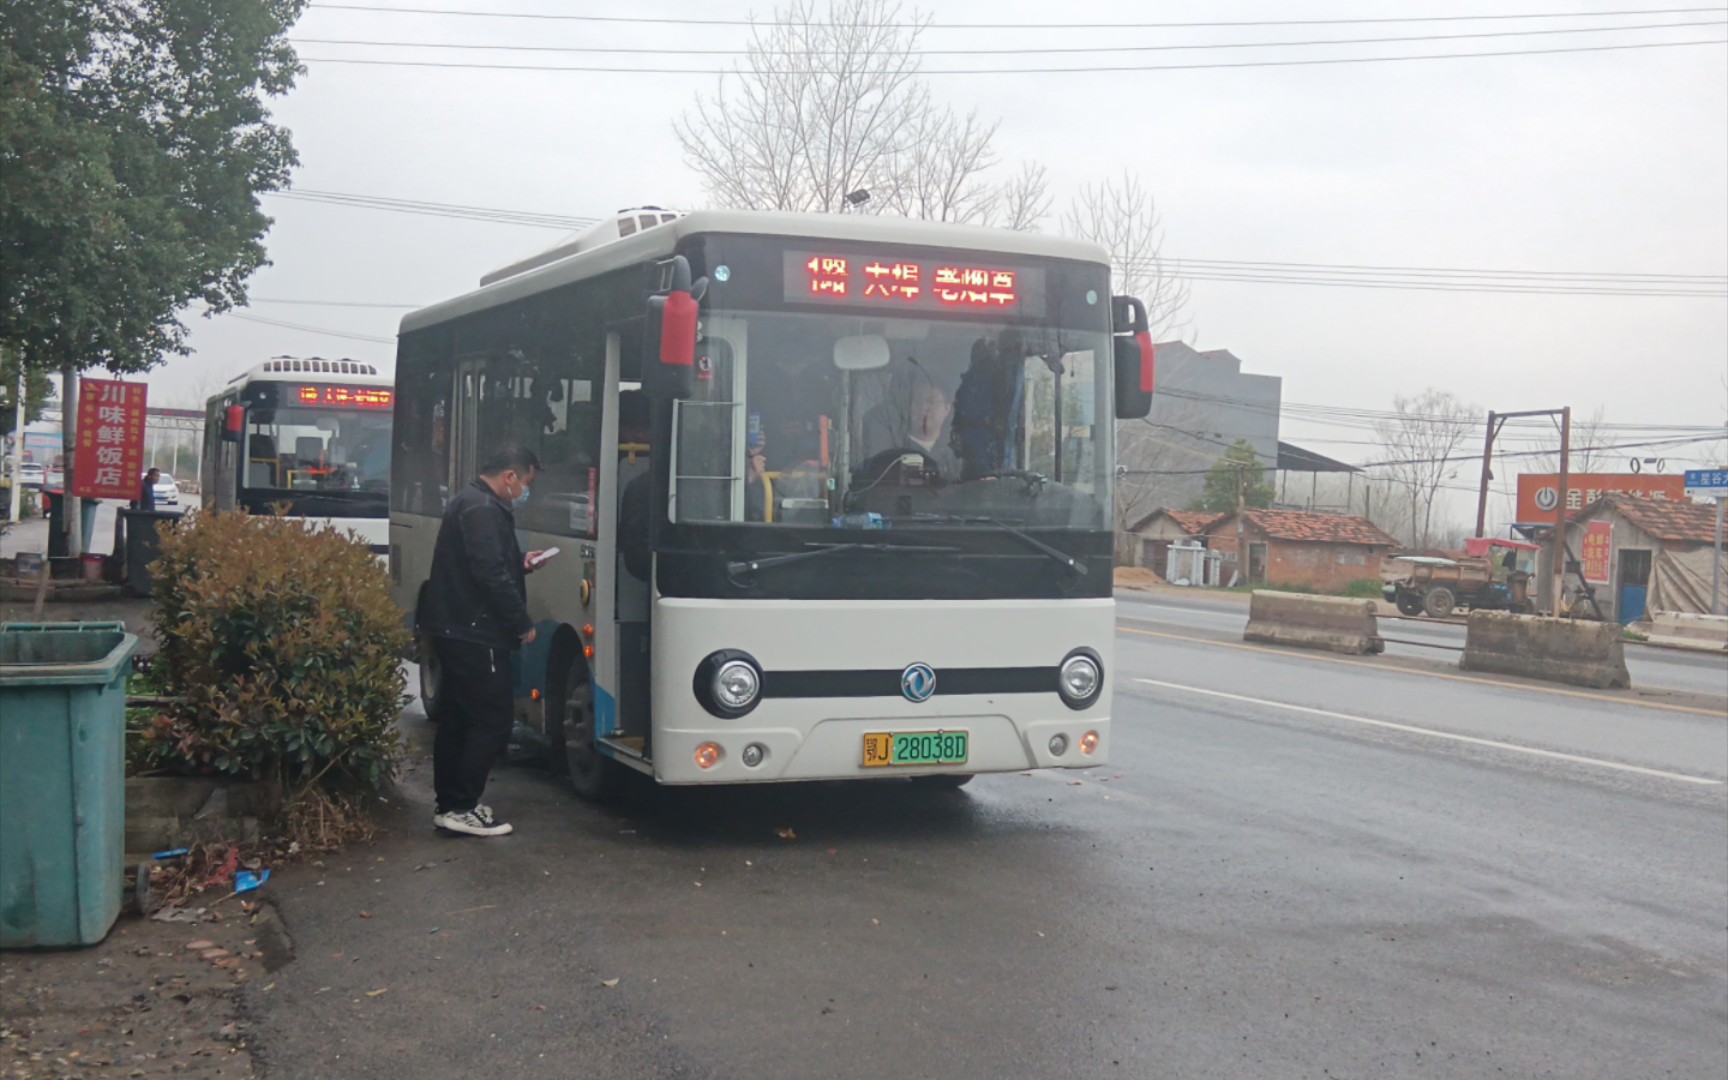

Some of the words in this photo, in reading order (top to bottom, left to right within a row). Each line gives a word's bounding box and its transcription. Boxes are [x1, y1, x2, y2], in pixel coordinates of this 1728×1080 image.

[94, 384, 126, 486] 川味鲜饭店
[898, 735, 966, 761] 28038D
